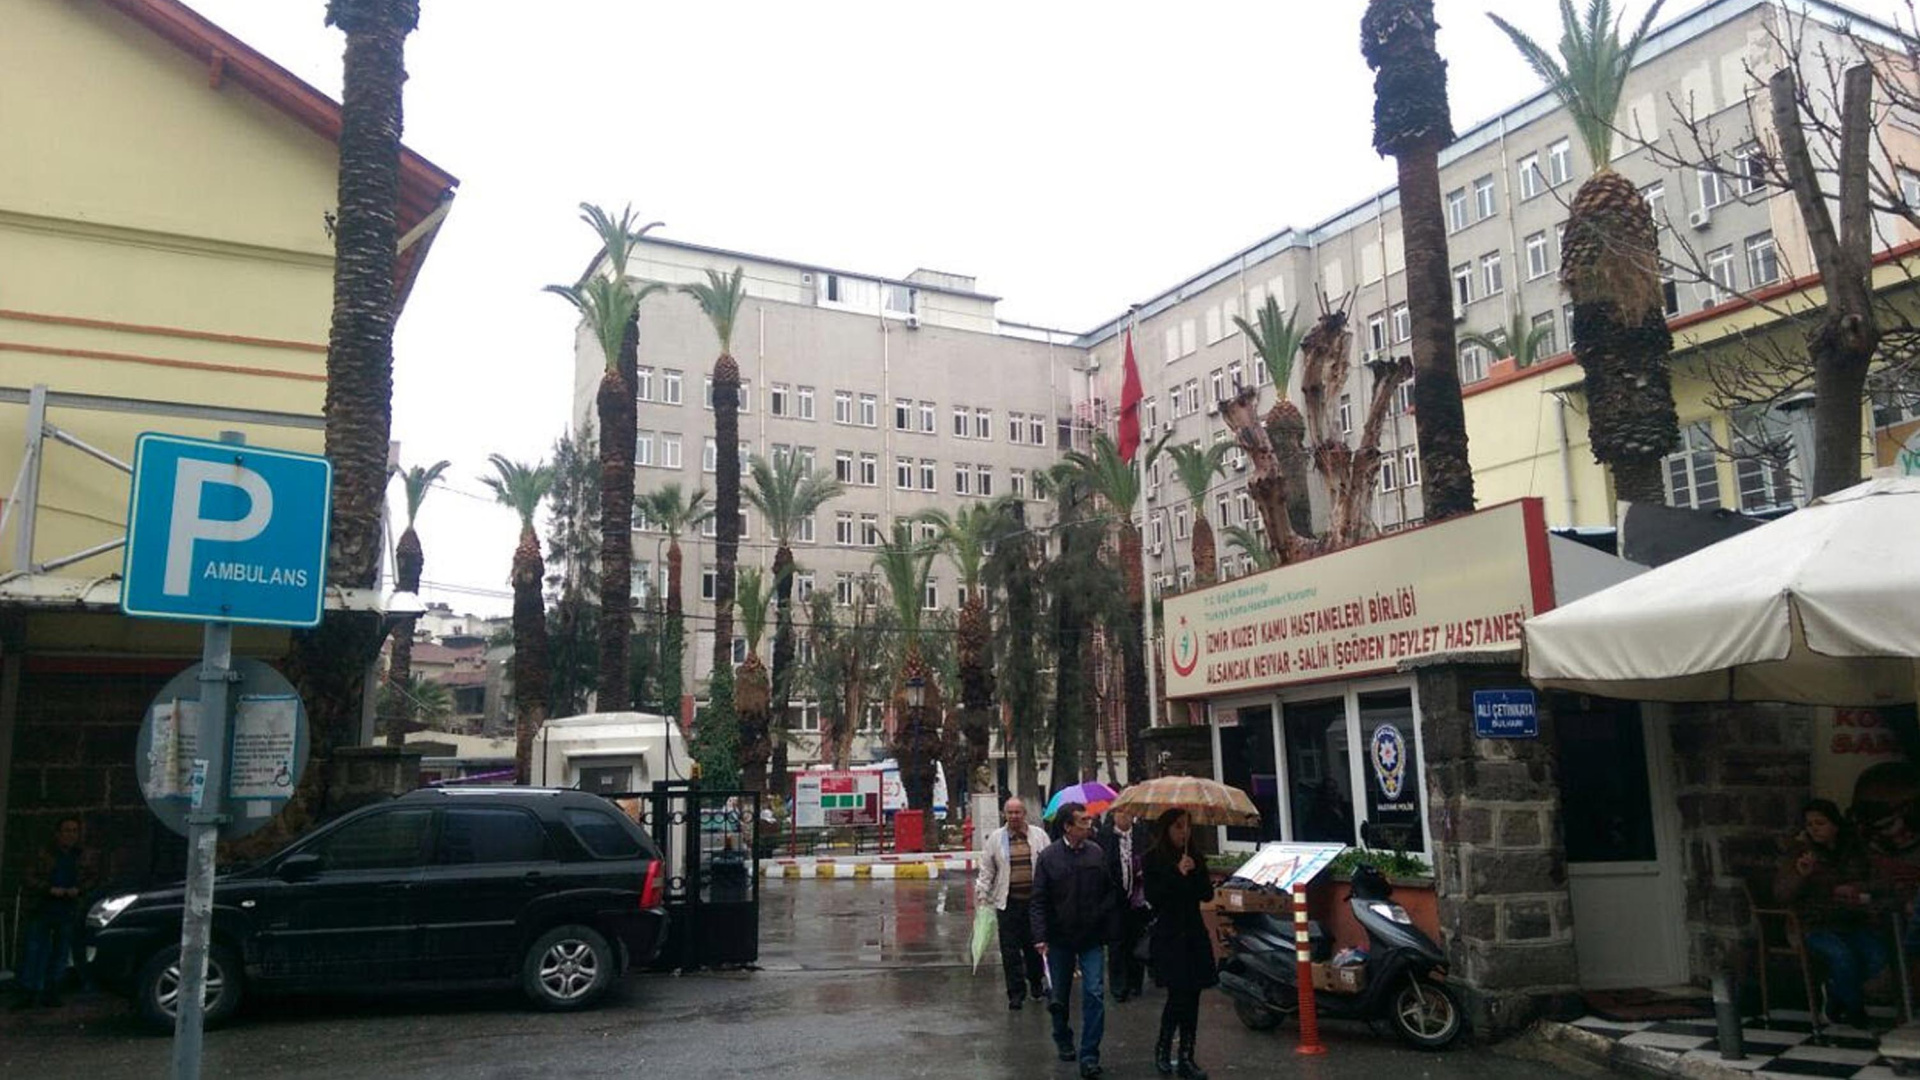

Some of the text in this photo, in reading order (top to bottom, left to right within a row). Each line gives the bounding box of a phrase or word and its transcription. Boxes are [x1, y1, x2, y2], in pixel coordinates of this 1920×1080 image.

[163, 457, 273, 596] P
[204, 561, 308, 588] AMBULANS
[1206, 584, 1417, 654] İZMİR KUZEY KAMU HASTANELERİ BİRLİĞİ
[1207, 657, 1252, 685] ALSANCAK
[1332, 631, 1384, 670] İŞGÖREN
[1389, 625, 1440, 658] DEVLET
